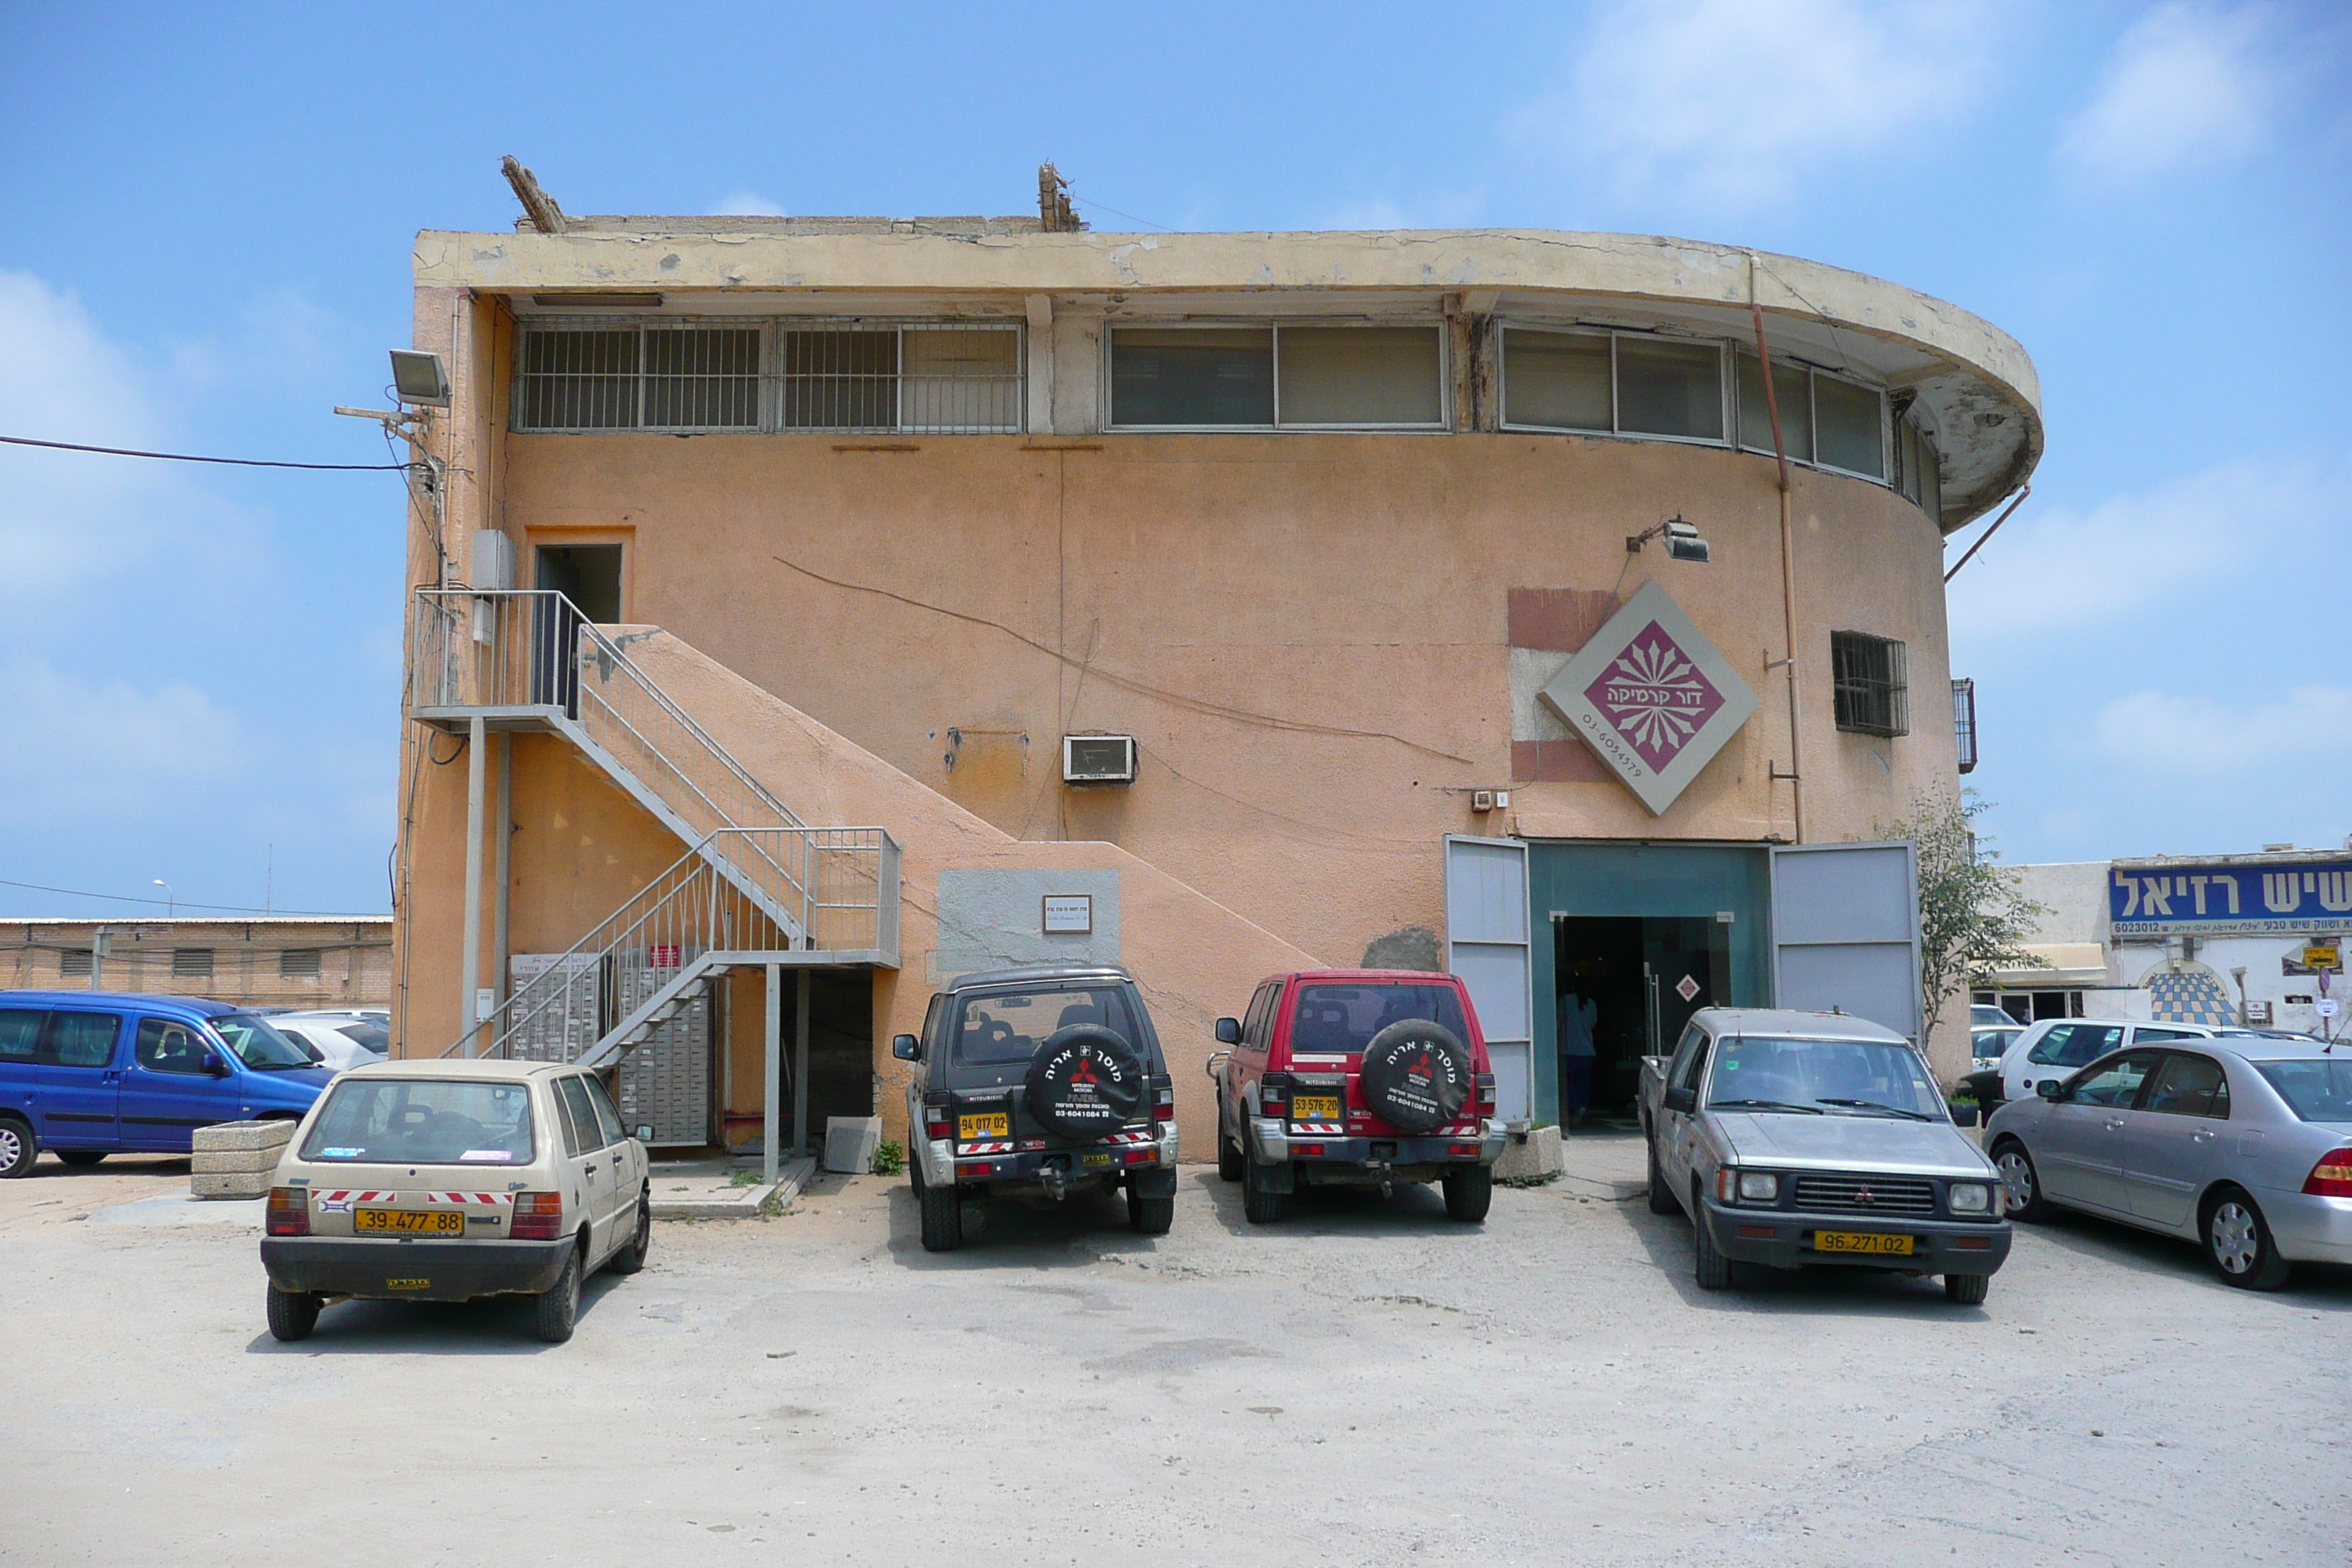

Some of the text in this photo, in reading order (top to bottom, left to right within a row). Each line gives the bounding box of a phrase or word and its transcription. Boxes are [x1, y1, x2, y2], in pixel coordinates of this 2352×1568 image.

[1607, 687, 1703, 705] דור קרמיקה
[1583, 714, 1642, 777] 03-6054579
[2115, 870, 2352, 916] שיש רזיאל
[2114, 921, 2159, 933] 6023012
[2264, 920, 2286, 931] טבעי
[2290, 919, 2310, 930] שיש
[2313, 919, 2340, 931] ושווק
[1044, 1049, 1122, 1082] מוסך אריה
[1387, 1041, 1456, 1084] מוסך אריה
[969, 1094, 1003, 1102] MITSUBISHI
[508, 1182, 527, 1191] Uno
[388, 1279, 429, 1287] מבדק
